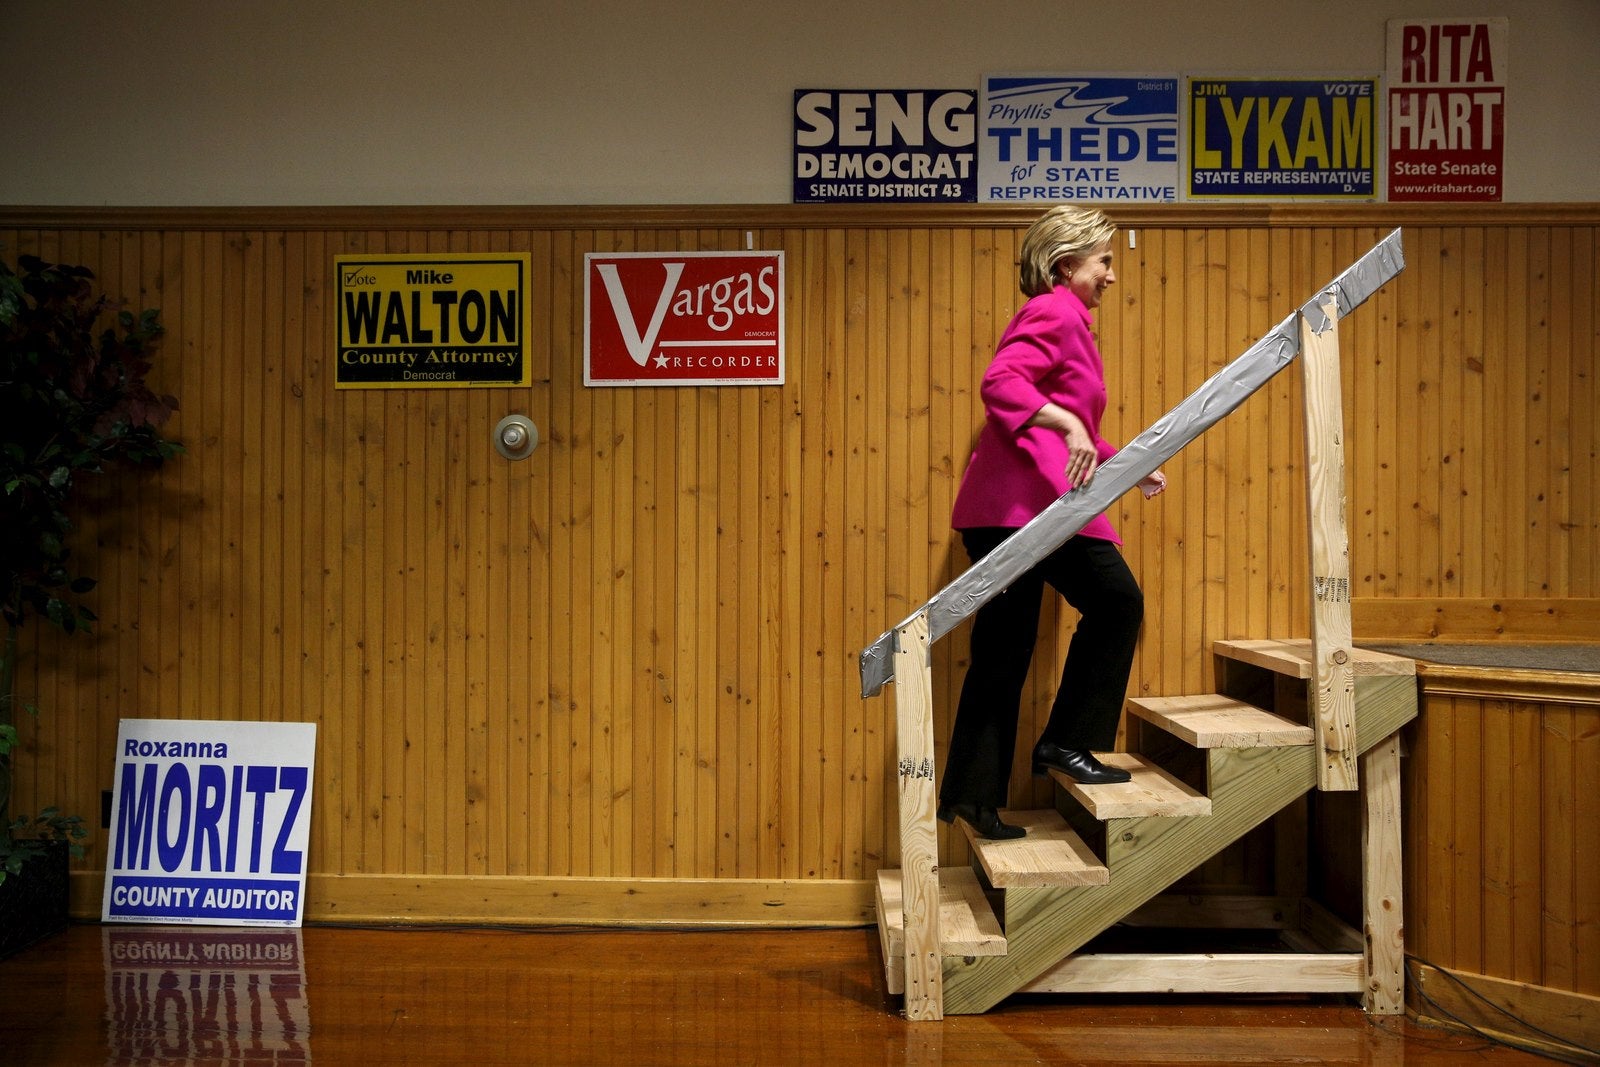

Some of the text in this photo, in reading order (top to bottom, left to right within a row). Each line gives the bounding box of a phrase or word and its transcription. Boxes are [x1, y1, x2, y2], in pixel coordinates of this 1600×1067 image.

[1402, 24, 1494, 83] RITA
[1137, 81, 1163, 91] District
[1195, 85, 1227, 96] JIM
[1323, 84, 1371, 96] VOTE
[796, 91, 975, 148] SENG
[988, 103, 1052, 124] Phyllis
[1391, 92, 1502, 151] HART
[1194, 97, 1371, 169] LYKAM
[987, 127, 1177, 162] THEDE
[797, 152, 974, 179] DEMOCRAT
[1011, 164, 1120, 183] for STATE
[1394, 161, 1497, 176] State Senate
[1194, 171, 1371, 184] STATE REPRESENTATIVE
[810, 184, 962, 197] SENATE DISTRICT 43
[990, 186, 1175, 199] REPRESENTATIVE
[1343, 184, 1356, 192] D.
[1394, 183, 1497, 196] www.ritahart.org
[406, 270, 454, 285] Mike
[345, 289, 516, 344] WALTON
[595, 262, 775, 368] Vargas
[342, 349, 519, 367] County Attorney
[674, 356, 776, 367] RECORDER
[403, 370, 456, 381] Democrat
[124, 739, 228, 758] Roxanna
[113, 762, 308, 874] MORITZ
[113, 885, 294, 911] COUNTY AUDITOR
